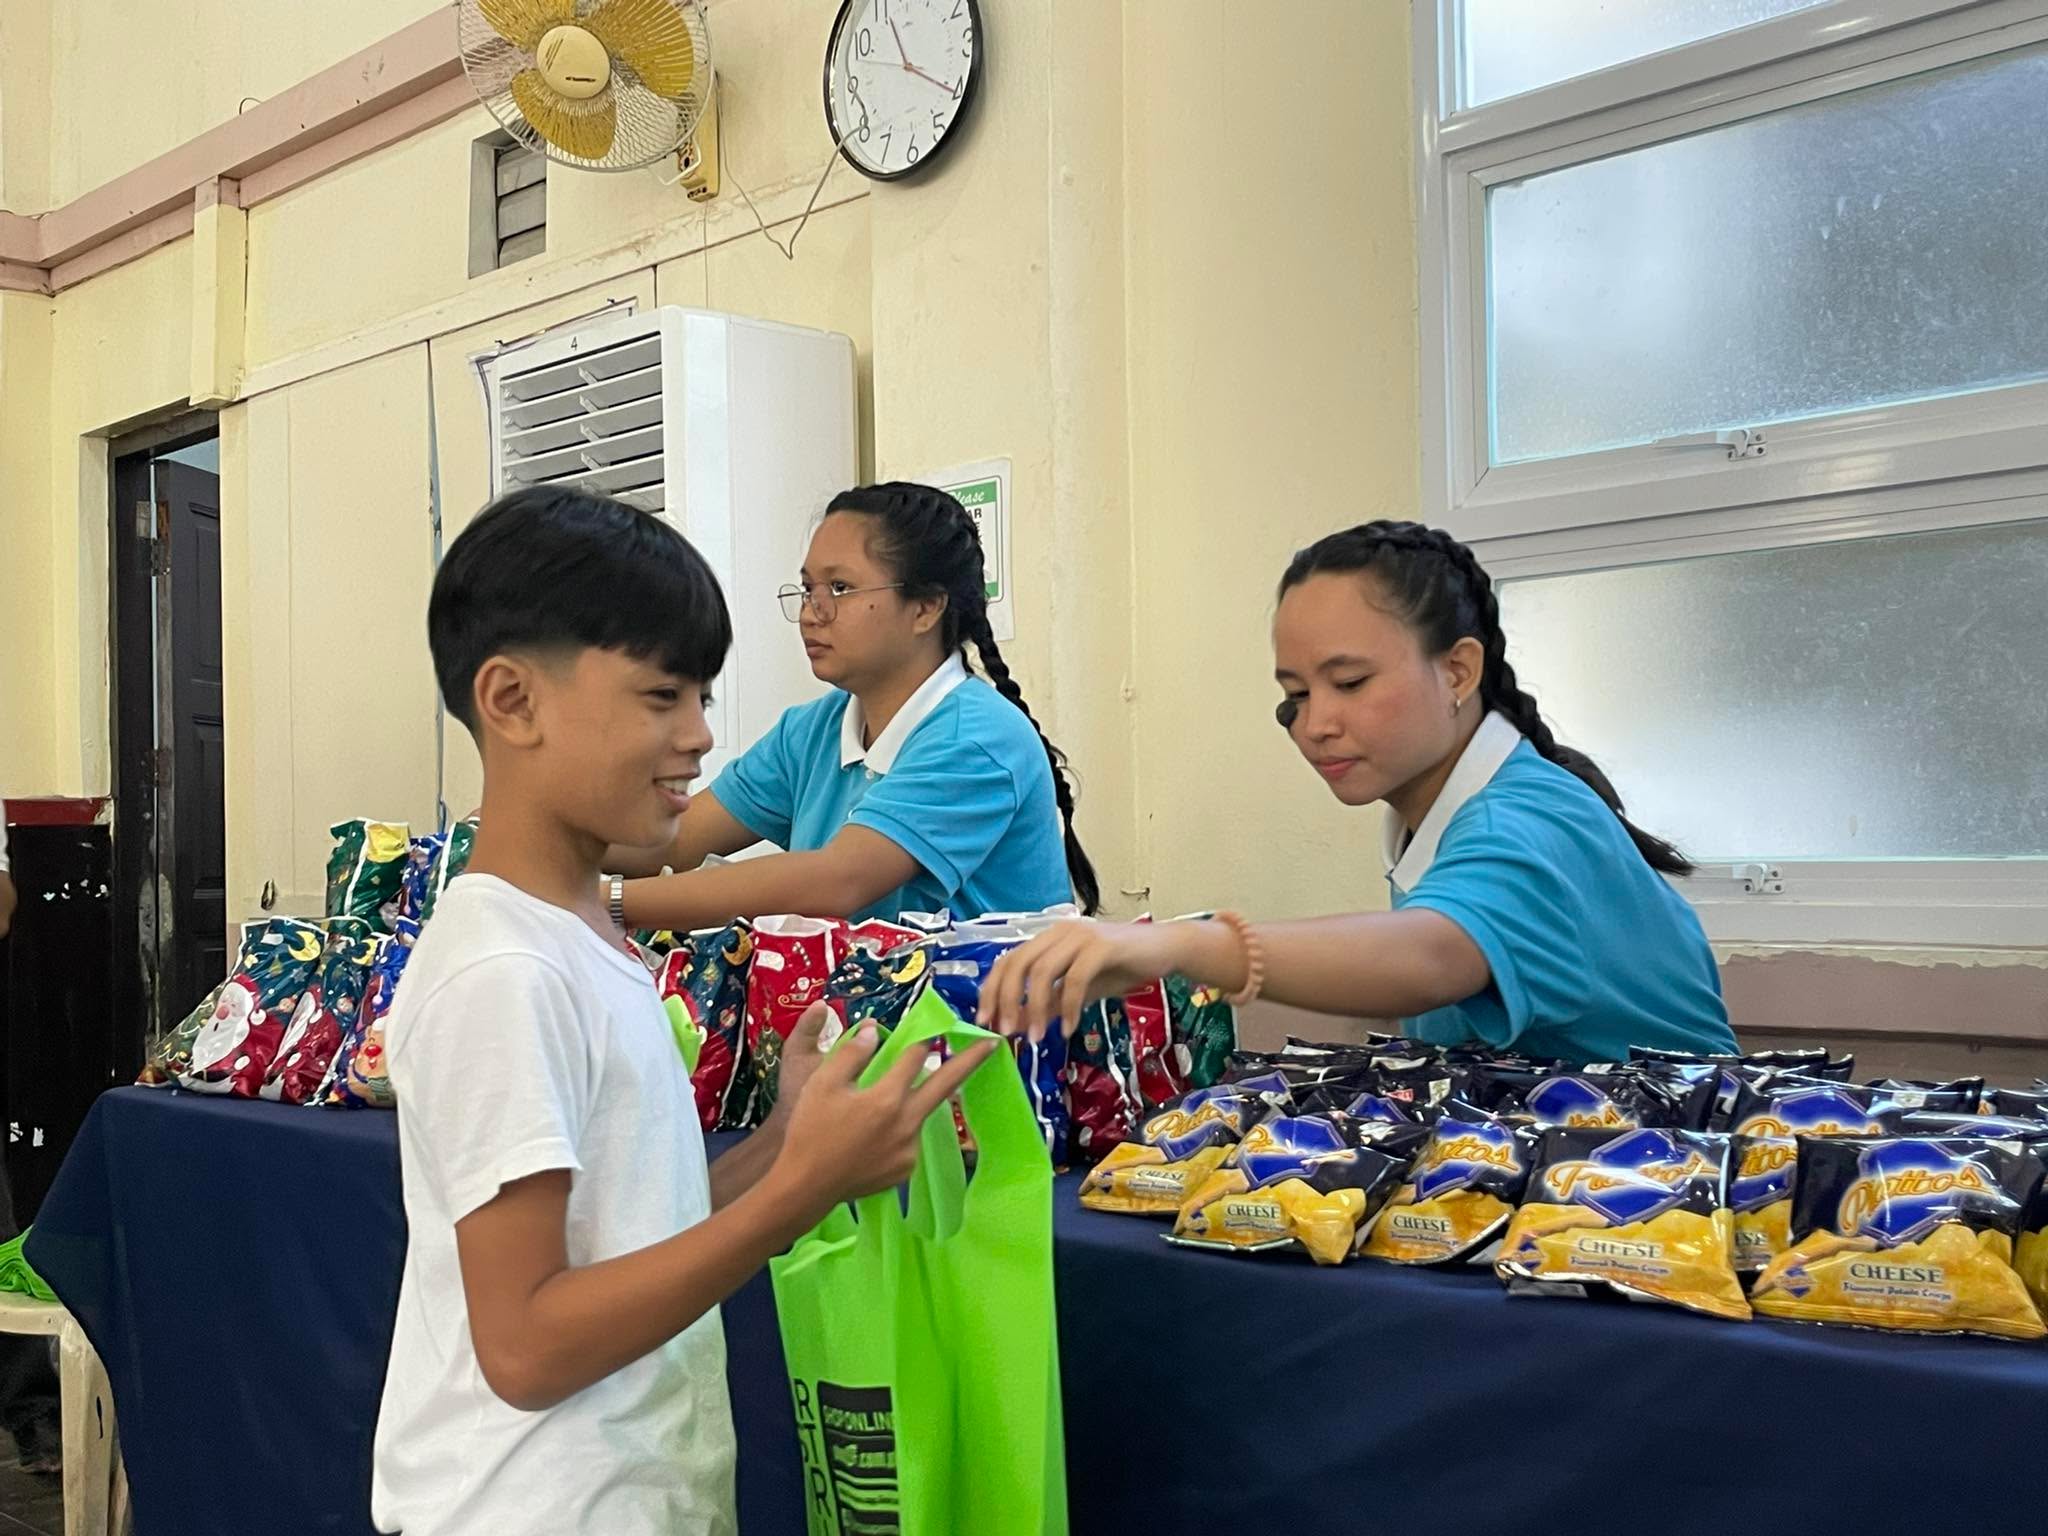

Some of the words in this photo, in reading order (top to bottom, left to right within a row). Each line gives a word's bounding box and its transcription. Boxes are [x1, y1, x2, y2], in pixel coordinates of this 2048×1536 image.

[855, 28, 871, 61] 10
[880, 133, 891, 165] 7
[906, 134, 919, 163] 6
[570, 336, 578, 351] 4
[1227, 1204, 1280, 1218] CHEESE
[1393, 1215, 1451, 1232] CHEESE
[1579, 1238, 1662, 1258] CHEESE
[1850, 1263, 1943, 1283] CHEESE
